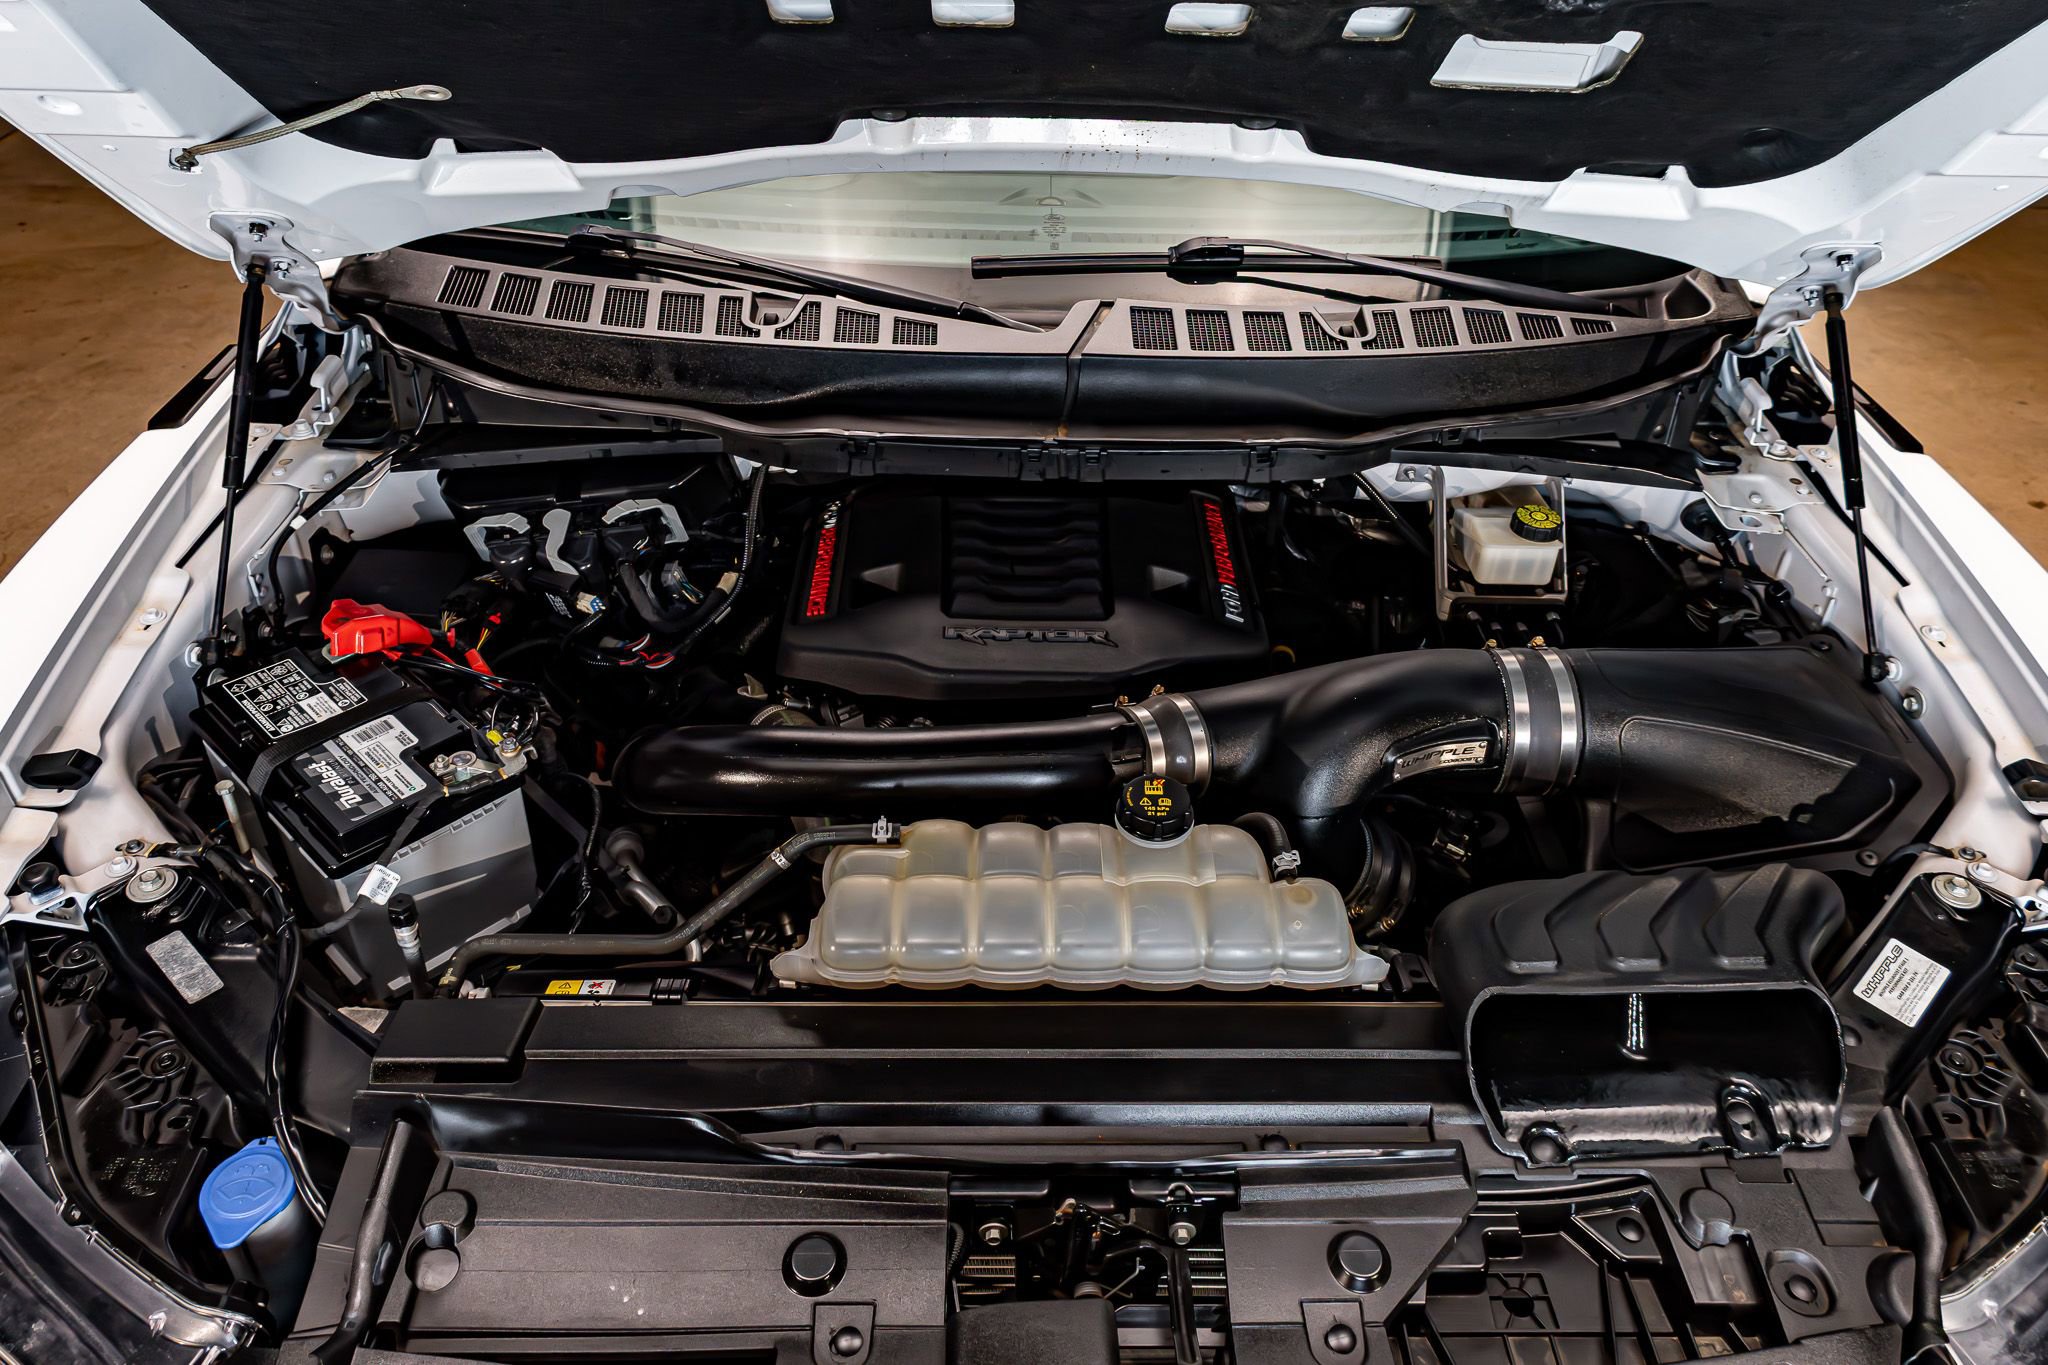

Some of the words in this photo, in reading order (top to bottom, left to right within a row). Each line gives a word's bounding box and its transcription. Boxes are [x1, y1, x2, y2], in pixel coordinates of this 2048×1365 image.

[943, 626, 1120, 648] RAPTOR
[1402, 746, 1477, 769] WHIPPLE
[307, 759, 363, 809] Duralast
[1861, 944, 1904, 999] WHIPPLE
